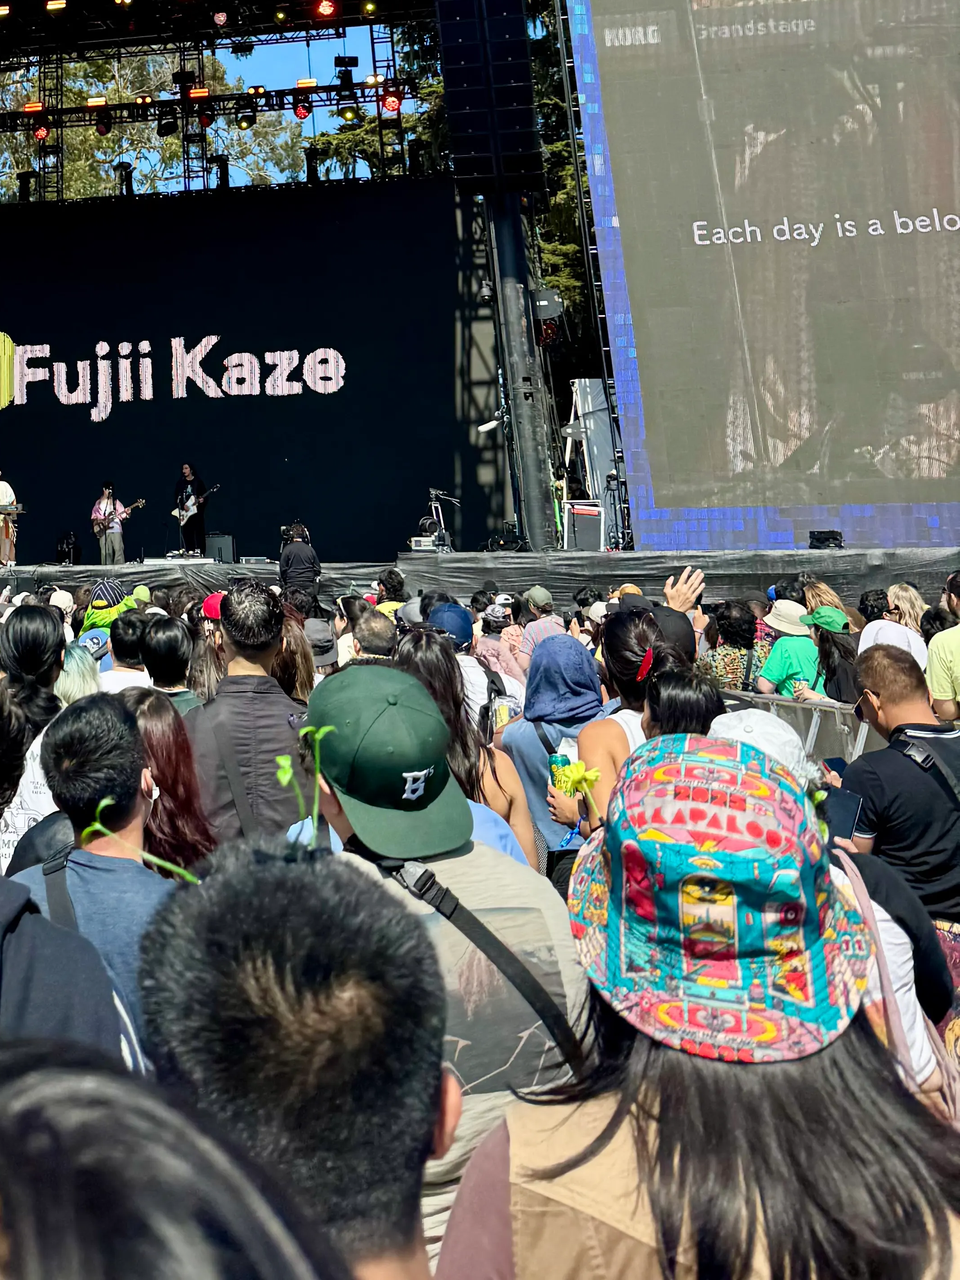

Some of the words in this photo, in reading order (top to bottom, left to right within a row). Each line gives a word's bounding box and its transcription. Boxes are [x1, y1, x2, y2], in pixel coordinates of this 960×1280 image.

[604, 25, 660, 47] KORG
[692, 219, 762, 245] Each
[773, 216, 824, 247] day
[834, 214, 857, 237] is
[868, 218, 885, 236] a
[13, 340, 154, 422] Fujii
[170, 334, 347, 399] Kaze
[673, 784, 747, 813] 2025
